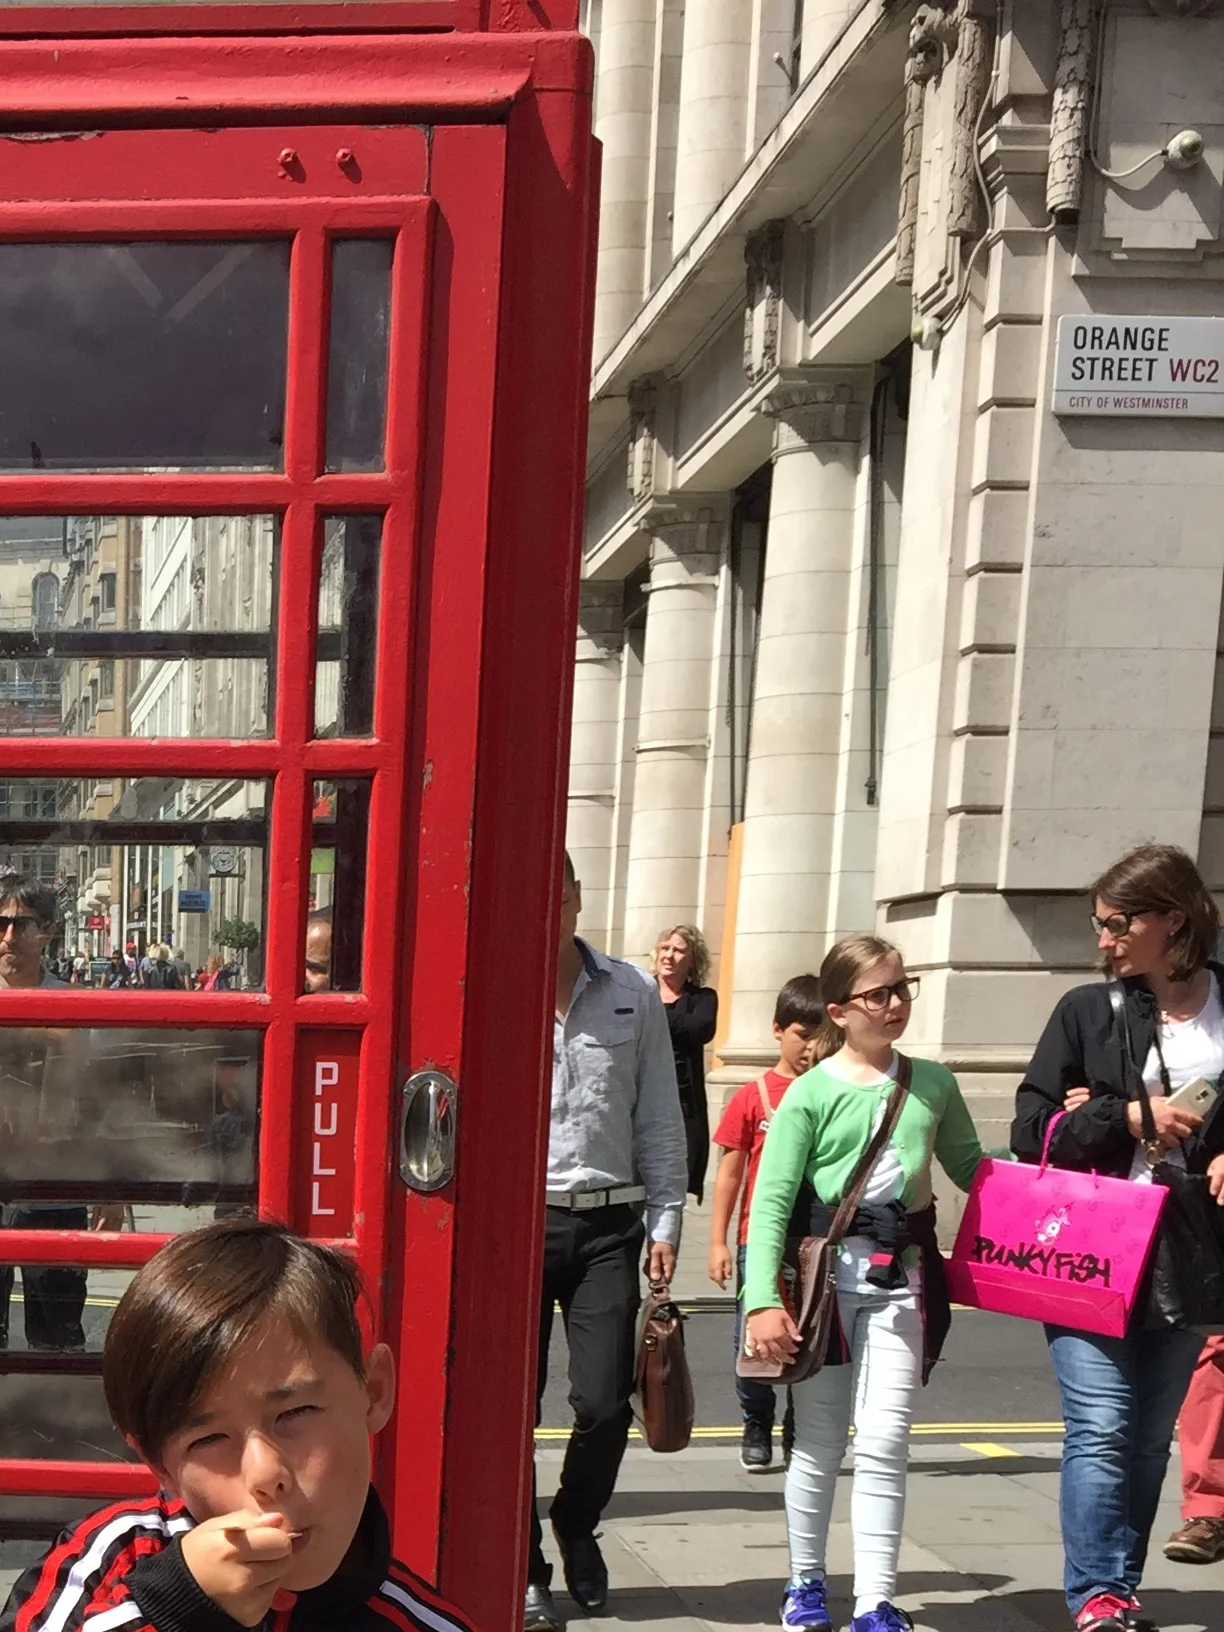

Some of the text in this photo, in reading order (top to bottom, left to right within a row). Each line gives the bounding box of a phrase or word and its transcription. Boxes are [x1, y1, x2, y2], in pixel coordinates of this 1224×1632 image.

[1073, 325, 1170, 352] ORANGE
[1071, 356, 1220, 383] STREET WC2
[1069, 396, 1189, 409] CITY OF WESTMINSTER
[312, 1062, 339, 1215] PULL
